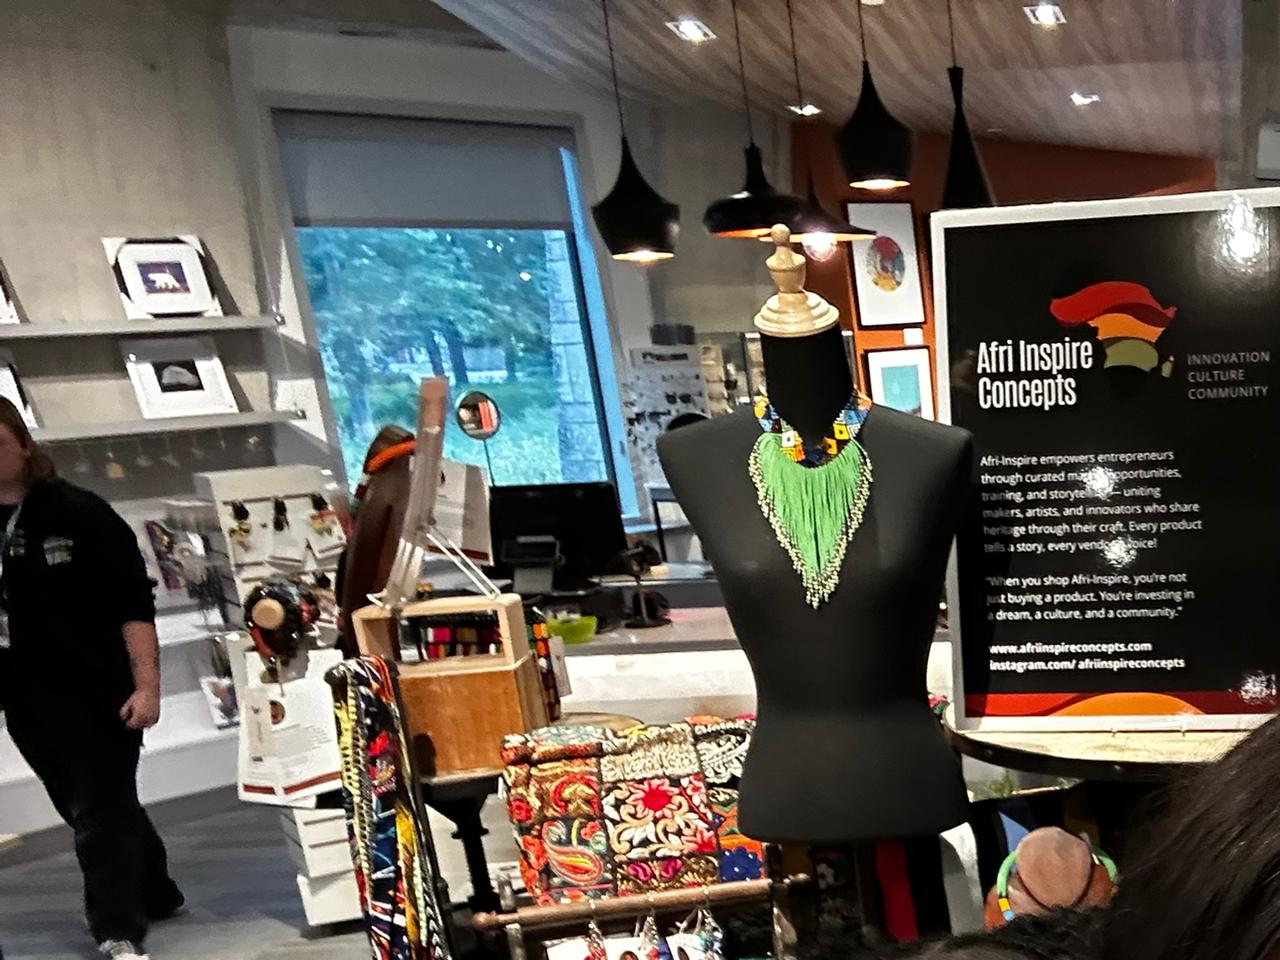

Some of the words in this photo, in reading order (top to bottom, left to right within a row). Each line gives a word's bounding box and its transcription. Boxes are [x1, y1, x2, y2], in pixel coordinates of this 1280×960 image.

[977, 339, 1014, 374] Afri
[1019, 336, 1093, 375] Inspire
[1187, 351, 1270, 366] INNOVATION
[1188, 369, 1246, 383] CULTURE
[978, 374, 1077, 411] Concepts
[1188, 385, 1268, 400] COMMUNITY
[980, 455, 1038, 468] Afri-Inspire
[1040, 454, 1096, 467] empowers
[1097, 451, 1174, 464] entrepreneurs
[980, 472, 1023, 486] through
[1024, 471, 1065, 483] curated
[1026, 489, 1047, 500] and
[1123, 486, 1161, 498] uniting
[1025, 506, 1061, 517] artists,
[1062, 505, 1083, 516] and
[1085, 504, 1141, 515] innovators
[1143, 502, 1167, 513] who
[1169, 502, 1200, 513] share
[1027, 523, 1070, 536] through
[1072, 522, 1096, 534] their
[1099, 521, 1127, 534] craft.
[1128, 521, 1158, 533] Every
[1160, 519, 1202, 533] product
[1016, 542, 1046, 554] story,
[1047, 542, 1077, 553] every
[1021, 577, 1041, 588] you
[1043, 574, 1069, 588] shop
[1071, 573, 1132, 586] Afri-Inspire,
[1168, 573, 1187, 583] not
[1007, 592, 1043, 606] buying
[1044, 593, 1052, 602] a
[1053, 591, 1098, 605] product.
[1134, 589, 1183, 602] investing
[1184, 589, 1195, 599] in
[995, 609, 1033, 621] dream,
[1034, 610, 1042, 620] a
[1043, 608, 1083, 620] culture,
[1084, 607, 1106, 619] and
[1107, 609, 1114, 618] a
[989, 642, 1152, 656] www.afriinspireconcepts.com
[989, 658, 1077, 673] instagram.com/
[1078, 658, 1186, 672] afriinspireconcepts
